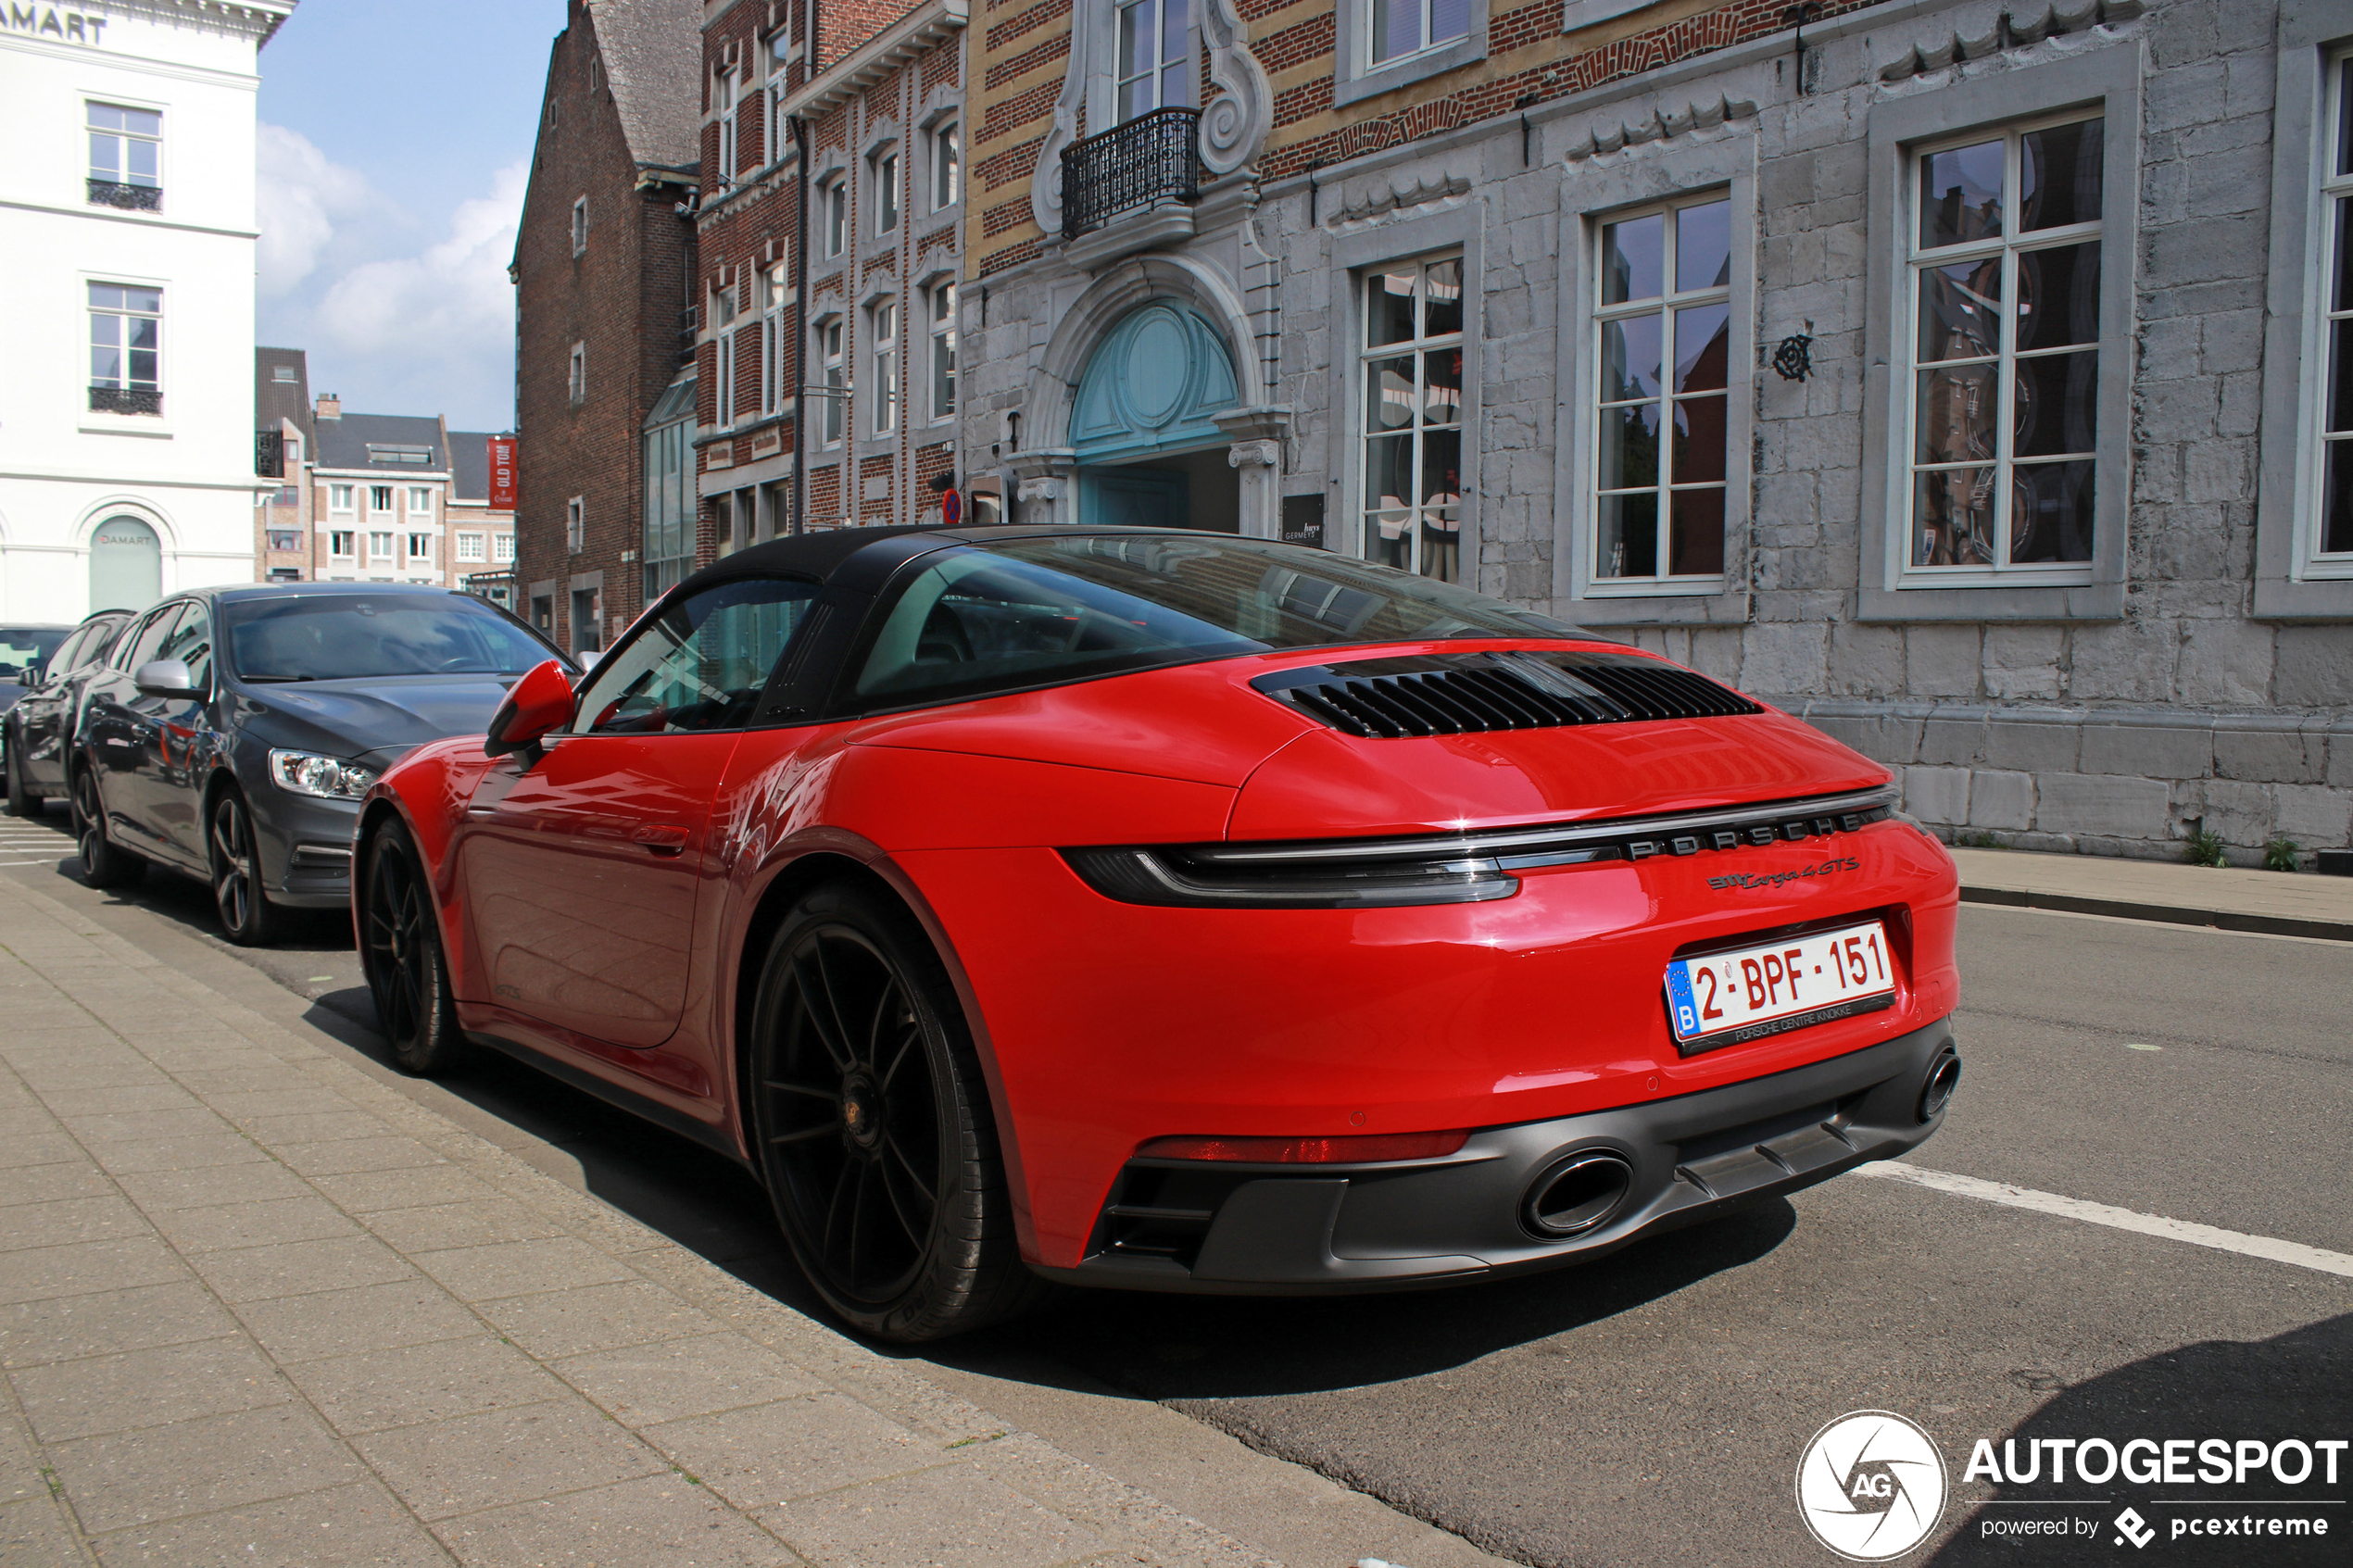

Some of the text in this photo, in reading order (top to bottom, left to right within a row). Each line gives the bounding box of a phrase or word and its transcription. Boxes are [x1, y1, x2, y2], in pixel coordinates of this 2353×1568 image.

[496, 445, 510, 466] TOM
[497, 468, 510, 488] OLD
[99, 534, 150, 546] DAMART
[1285, 532, 1315, 540] GERMEYS
[1628, 813, 1861, 861] PORSCHE
[1801, 864, 1816, 877] 4
[1818, 857, 1860, 875] GTS
[1679, 1005, 1695, 1031] B
[1735, 1004, 1852, 1041] PORSCHE CENTRE KNOKKE
